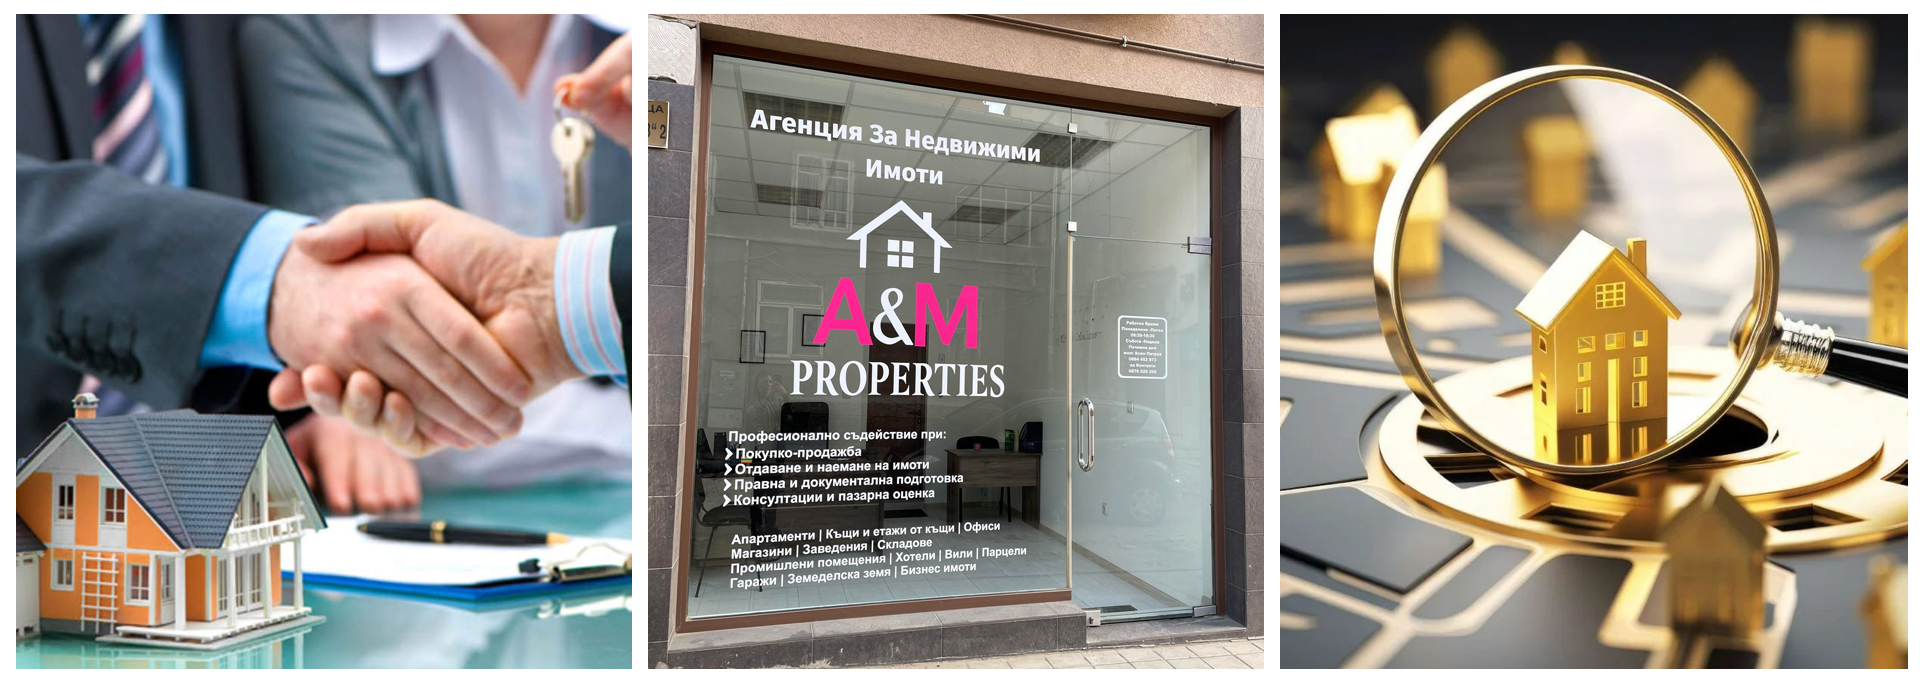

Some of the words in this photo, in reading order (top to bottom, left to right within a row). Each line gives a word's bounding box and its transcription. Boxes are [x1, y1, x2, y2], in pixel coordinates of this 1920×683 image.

[660, 124, 666, 139] 2
[750, 109, 863, 142] Агенция
[869, 124, 898, 146] За
[905, 128, 1040, 162] Недвижими
[866, 158, 943, 185] Имоти
[812, 277, 978, 350] A&M
[790, 359, 1005, 398] PROPERTIES
[728, 430, 840, 444] Професионално
[843, 429, 918, 442] съдействие
[921, 431, 946, 442] при:
[736, 445, 862, 461] Покупко-продажба
[735, 463, 801, 476] Отдаване
[805, 464, 813, 473] и
[817, 463, 871, 472] наемане
[875, 462, 889, 471] на
[893, 461, 930, 470] имоти
[734, 479, 785, 493] Правна
[790, 480, 798, 488] и
[801, 476, 893, 490] документална
[897, 475, 963, 486] подготовка
[734, 494, 823, 507] Консултации
[827, 493, 834, 502] и
[838, 491, 889, 503] пазарна
[893, 489, 935, 500] оценка
[731, 532, 815, 546] Апартаменти
[826, 528, 859, 539] Къщи
[873, 527, 907, 536] етажи
[910, 526, 923, 535] от
[925, 525, 955, 534] къщи
[964, 522, 1000, 534] Офиси
[731, 548, 792, 559] Магазини
[803, 543, 867, 554] Заведения
[877, 539, 933, 550] Складове
[731, 560, 814, 576] Промишлени
[818, 555, 886, 567] помещения
[895, 552, 935, 562] Хотели
[945, 549, 973, 559] Вили
[982, 547, 1027, 559] Парцели
[730, 577, 777, 590] Гаражи
[787, 571, 860, 584] Земеделска
[863, 569, 891, 578] земя
[901, 565, 941, 575] Бизнес
[943, 563, 976, 573] имоти
